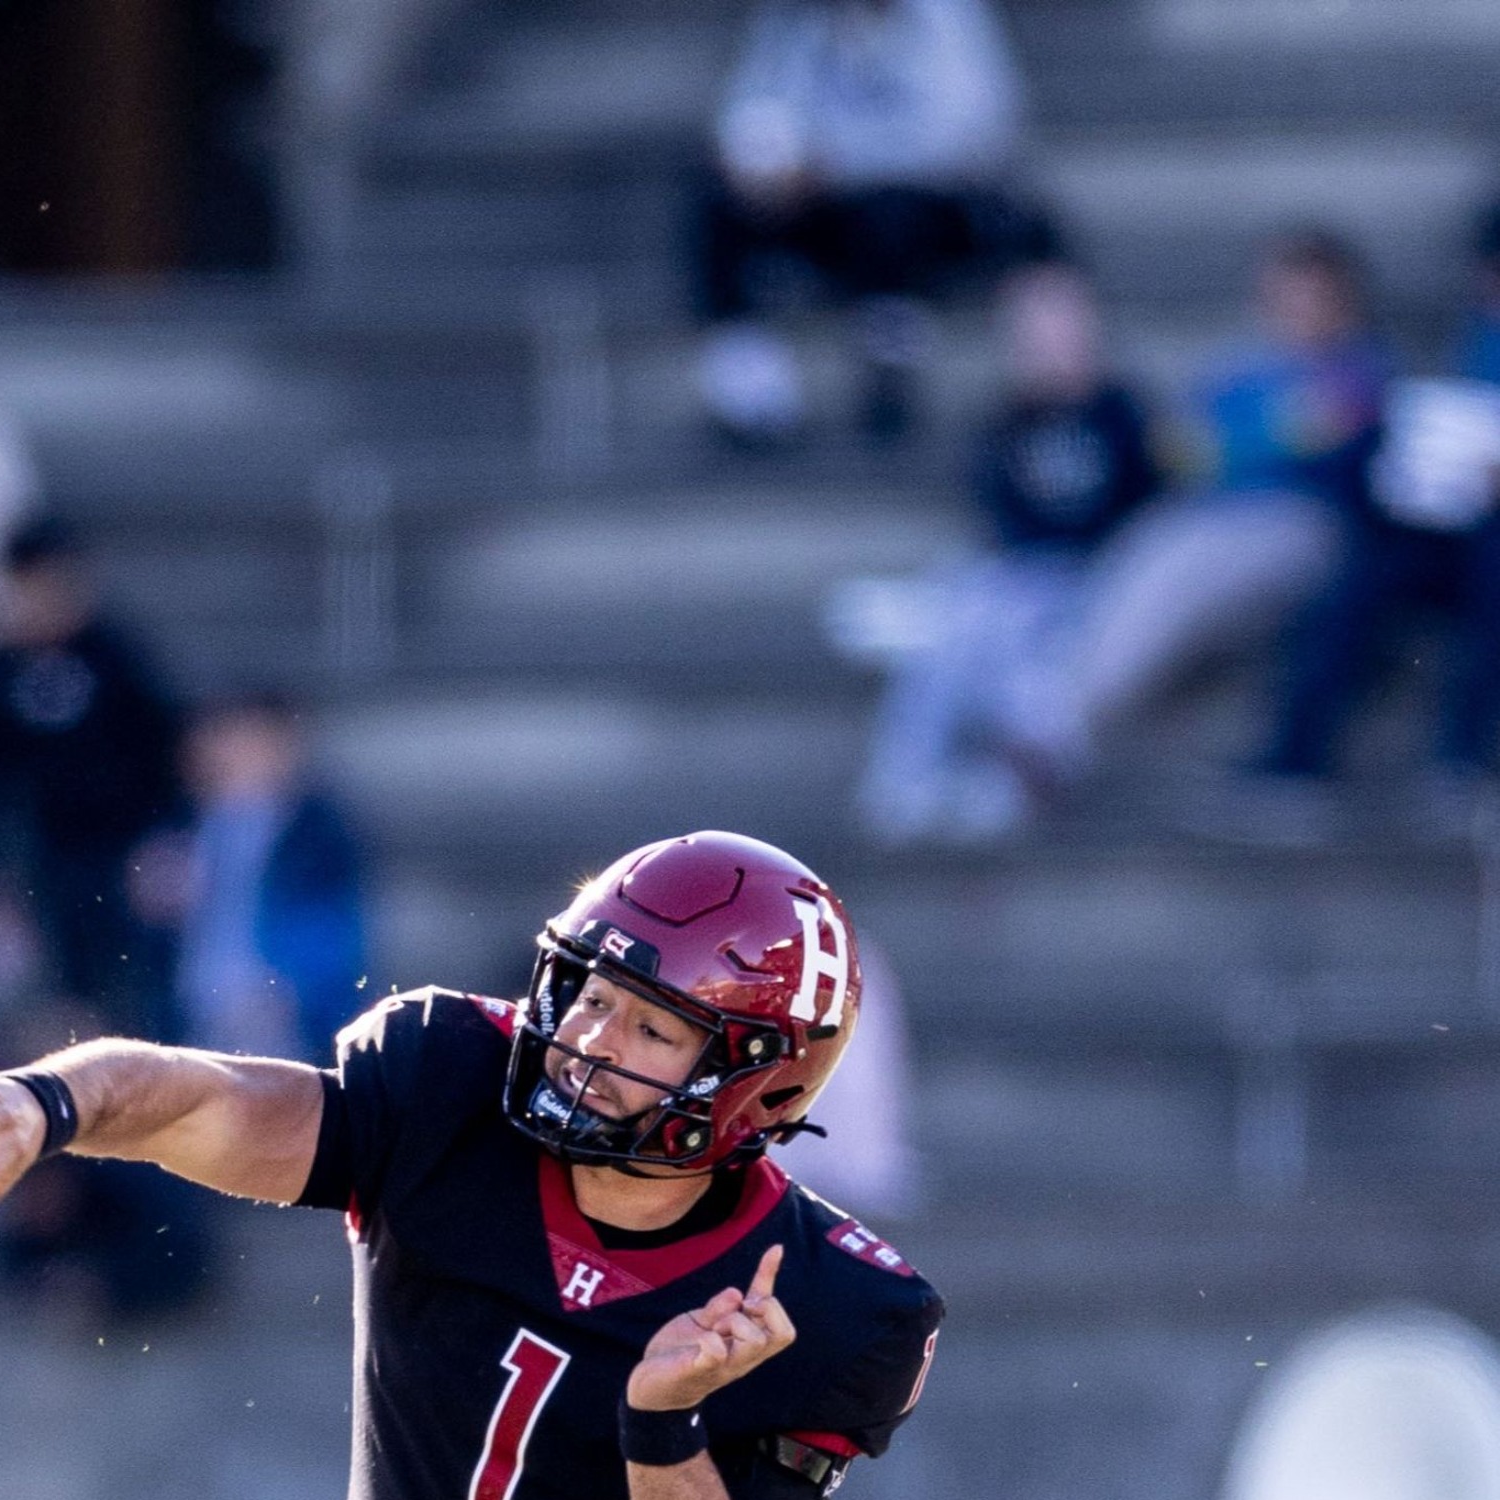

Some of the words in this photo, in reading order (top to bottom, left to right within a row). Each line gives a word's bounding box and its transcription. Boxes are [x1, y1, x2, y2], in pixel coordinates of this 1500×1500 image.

[789, 897, 848, 1026] H
[538, 1092, 572, 1121] Riddel
[562, 1262, 605, 1306] H
